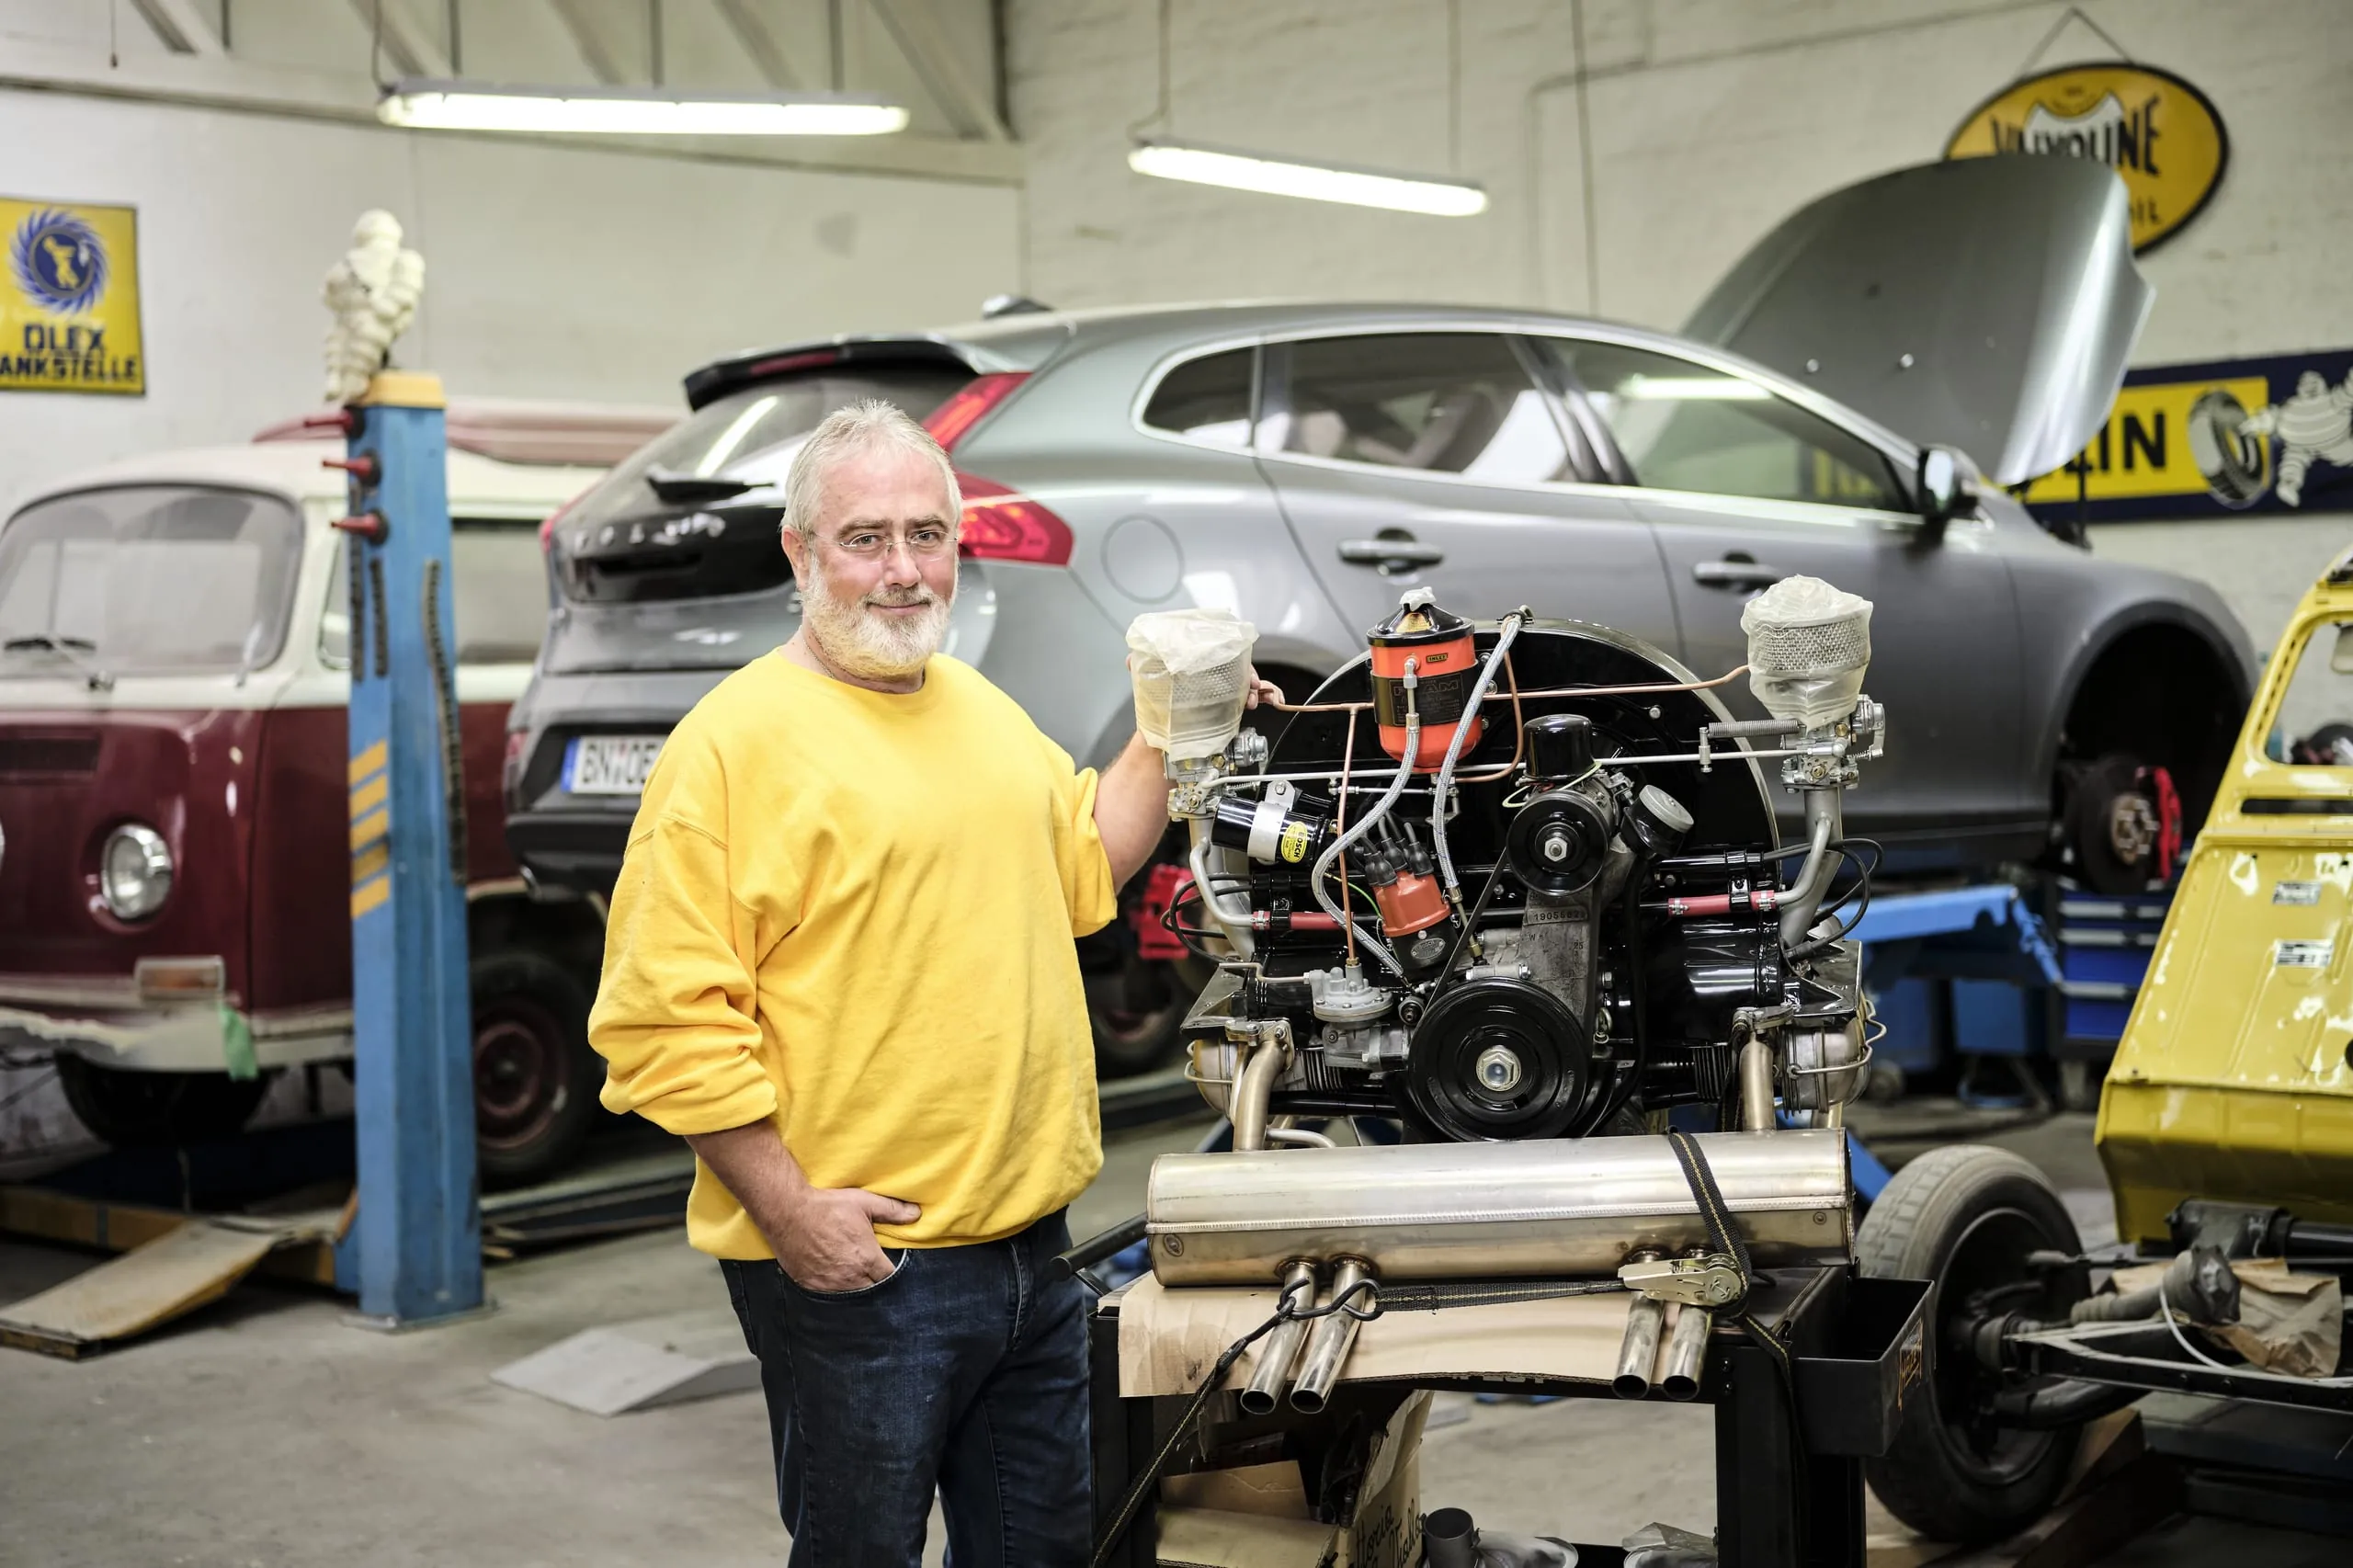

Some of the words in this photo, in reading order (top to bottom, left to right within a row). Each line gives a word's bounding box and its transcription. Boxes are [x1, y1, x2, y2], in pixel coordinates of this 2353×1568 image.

[25, 324, 105, 351] OLEX
[0, 354, 136, 381] ANKSTELLE
[1294, 832, 1305, 858] BOSCH
